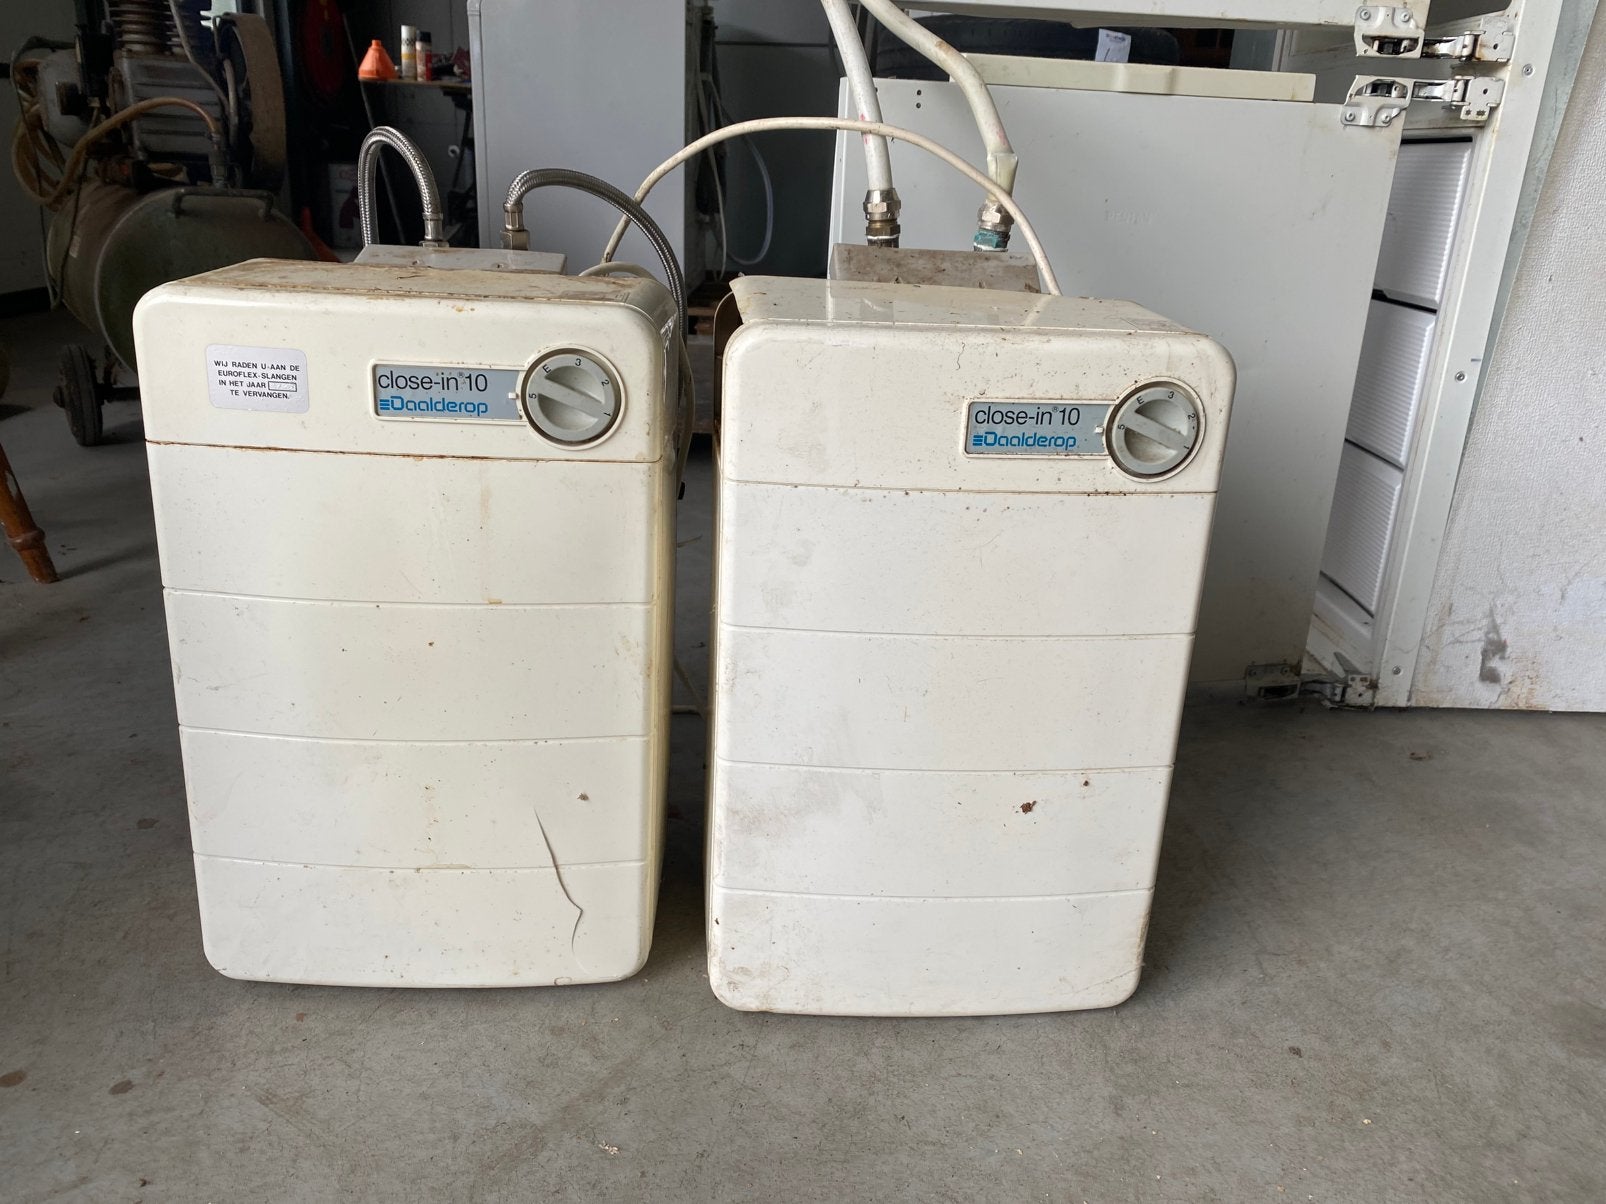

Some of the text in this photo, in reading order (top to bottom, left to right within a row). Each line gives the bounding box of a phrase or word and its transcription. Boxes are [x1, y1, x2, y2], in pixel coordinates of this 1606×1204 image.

[231, 361, 258, 369] RADEN
[574, 358, 582, 367] 3
[465, 373, 488, 392] 10
[601, 379, 610, 387] 2
[1167, 391, 1175, 400] 3
[390, 395, 488, 417] Daalderop
[1059, 407, 1081, 426] 10
[1187, 412, 1196, 420] 2
[983, 431, 1077, 451] Daalderop
